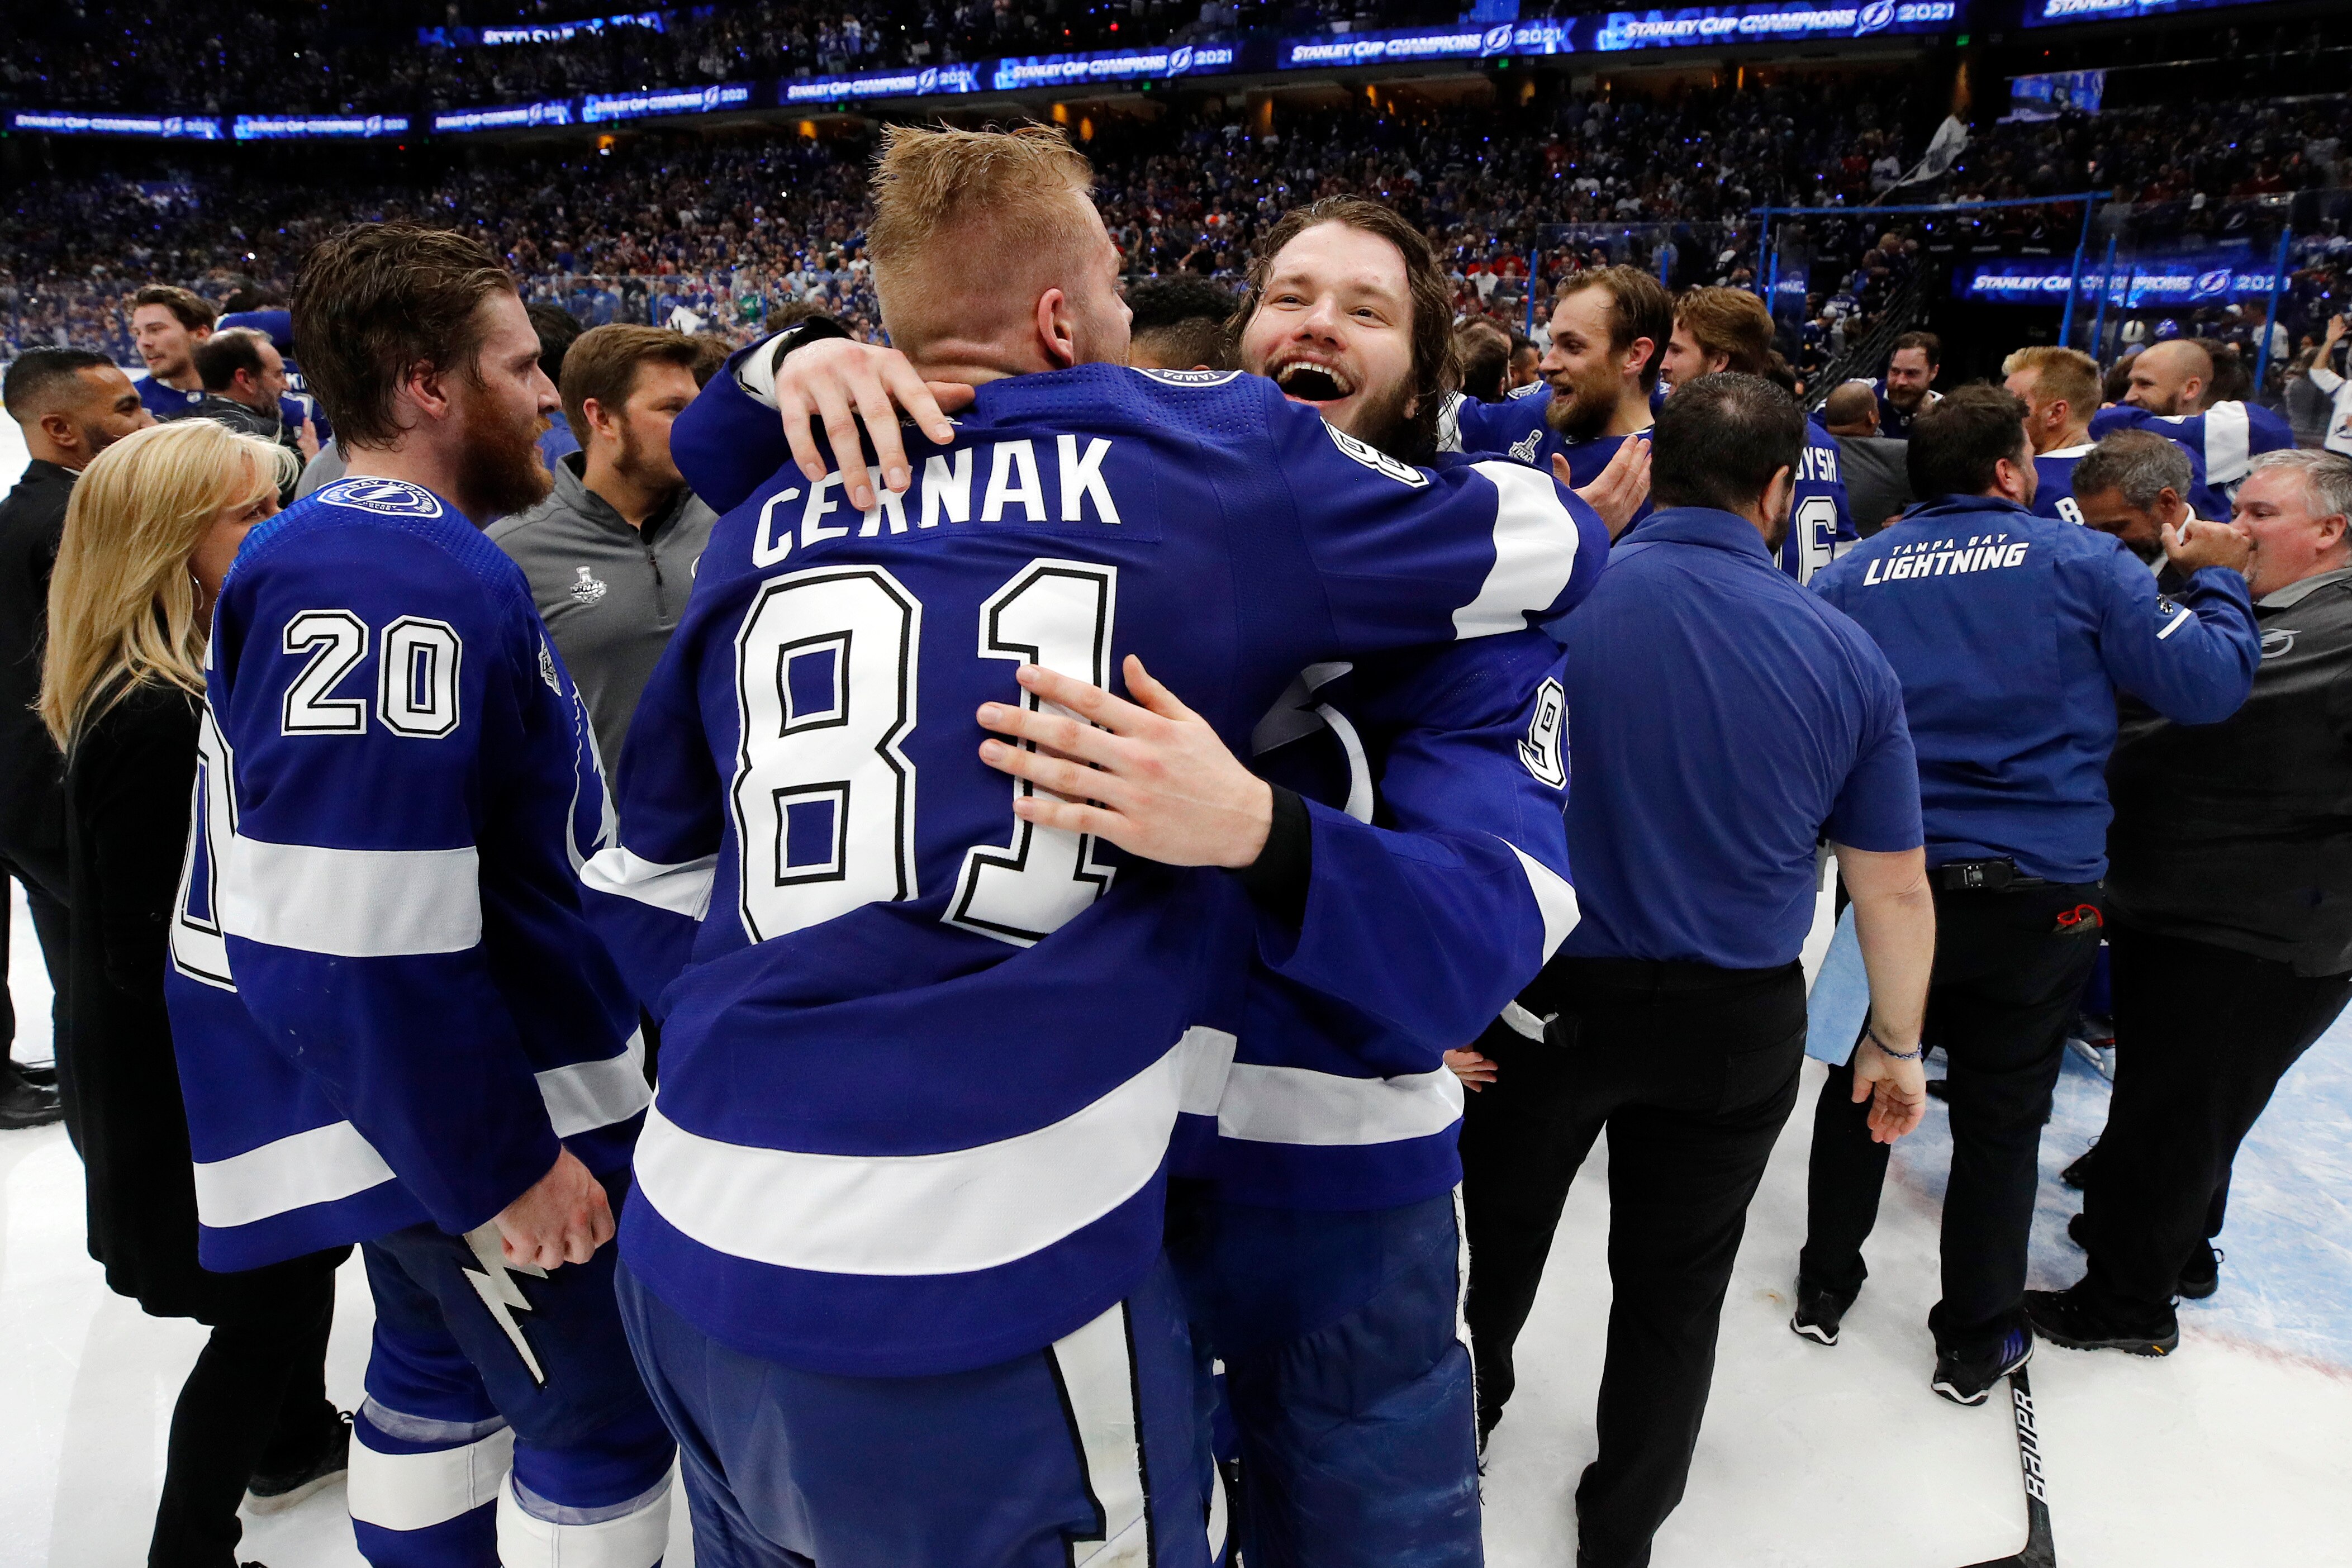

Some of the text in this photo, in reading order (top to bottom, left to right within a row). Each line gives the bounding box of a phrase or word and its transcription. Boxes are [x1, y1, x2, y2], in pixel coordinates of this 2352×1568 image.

[1626, 2, 1955, 39] STANLEY CUP CHAMPIONS 2021
[1291, 28, 1561, 62] STANLEY CUP CHAMPIONS 2021
[1013, 49, 1232, 79] STANLEY CUP CHAMPIONS 2021
[720, 88, 748, 102] 2021
[787, 70, 971, 99] STANLEY CUP CHAMPIONS 2021
[1973, 275, 2045, 290] STANLEY
[1163, 372, 1220, 381] TAMPA
[388, 481, 434, 513] LIGHTNING
[752, 434, 1121, 569] CERNAK
[1893, 534, 2007, 555] TAMPA BAY
[1862, 543, 2030, 586] LIGHTNING
[281, 609, 463, 739] 20
[730, 557, 1118, 949] 81
[2013, 1388, 2047, 1506] BAUER
